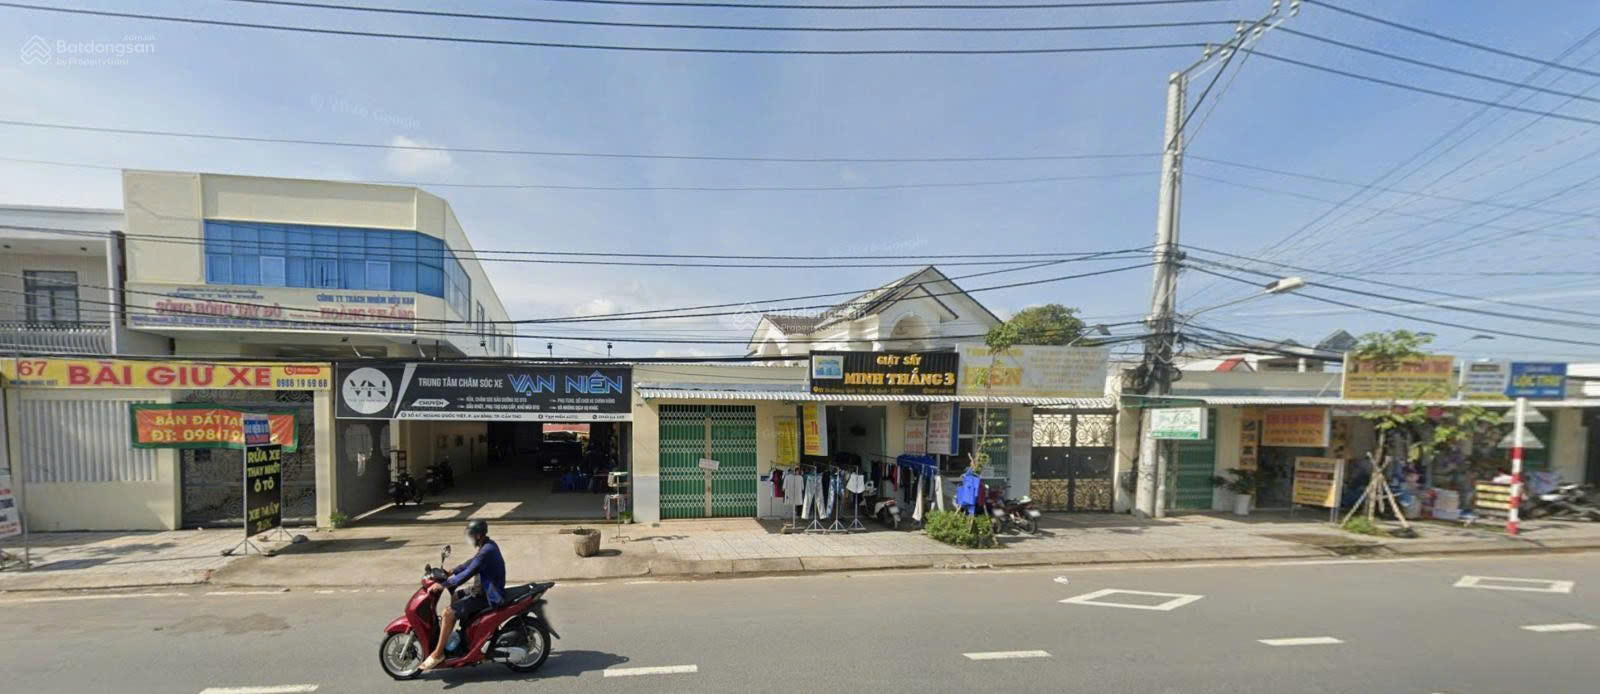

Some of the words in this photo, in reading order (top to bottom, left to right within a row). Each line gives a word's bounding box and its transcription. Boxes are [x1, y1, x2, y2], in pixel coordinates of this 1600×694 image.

[876, 354, 900, 367] GIẶT
[903, 353, 922, 366] SẤY
[18, 361, 48, 377] 67
[68, 361, 132, 386] BÃI
[146, 362, 215, 386] GIỮ
[227, 367, 271, 386] XE
[844, 372, 884, 385] MINH
[886, 367, 943, 386] THẮNG
[943, 372, 955, 386] 3
[418, 377, 441, 387] TRUNG
[443, 376, 457, 387] TÂM
[459, 377, 478, 388] CHĂM
[480, 377, 493, 388] SÓC
[494, 379, 503, 388] XE
[507, 374, 555, 397] VẠN
[565, 370, 622, 394] NIÊN
[156, 412, 187, 425] BÁN
[247, 447, 268, 463] RỬA
[269, 449, 281, 461] XE
[247, 466, 264, 478] THAY
[249, 508, 261, 521] XE
